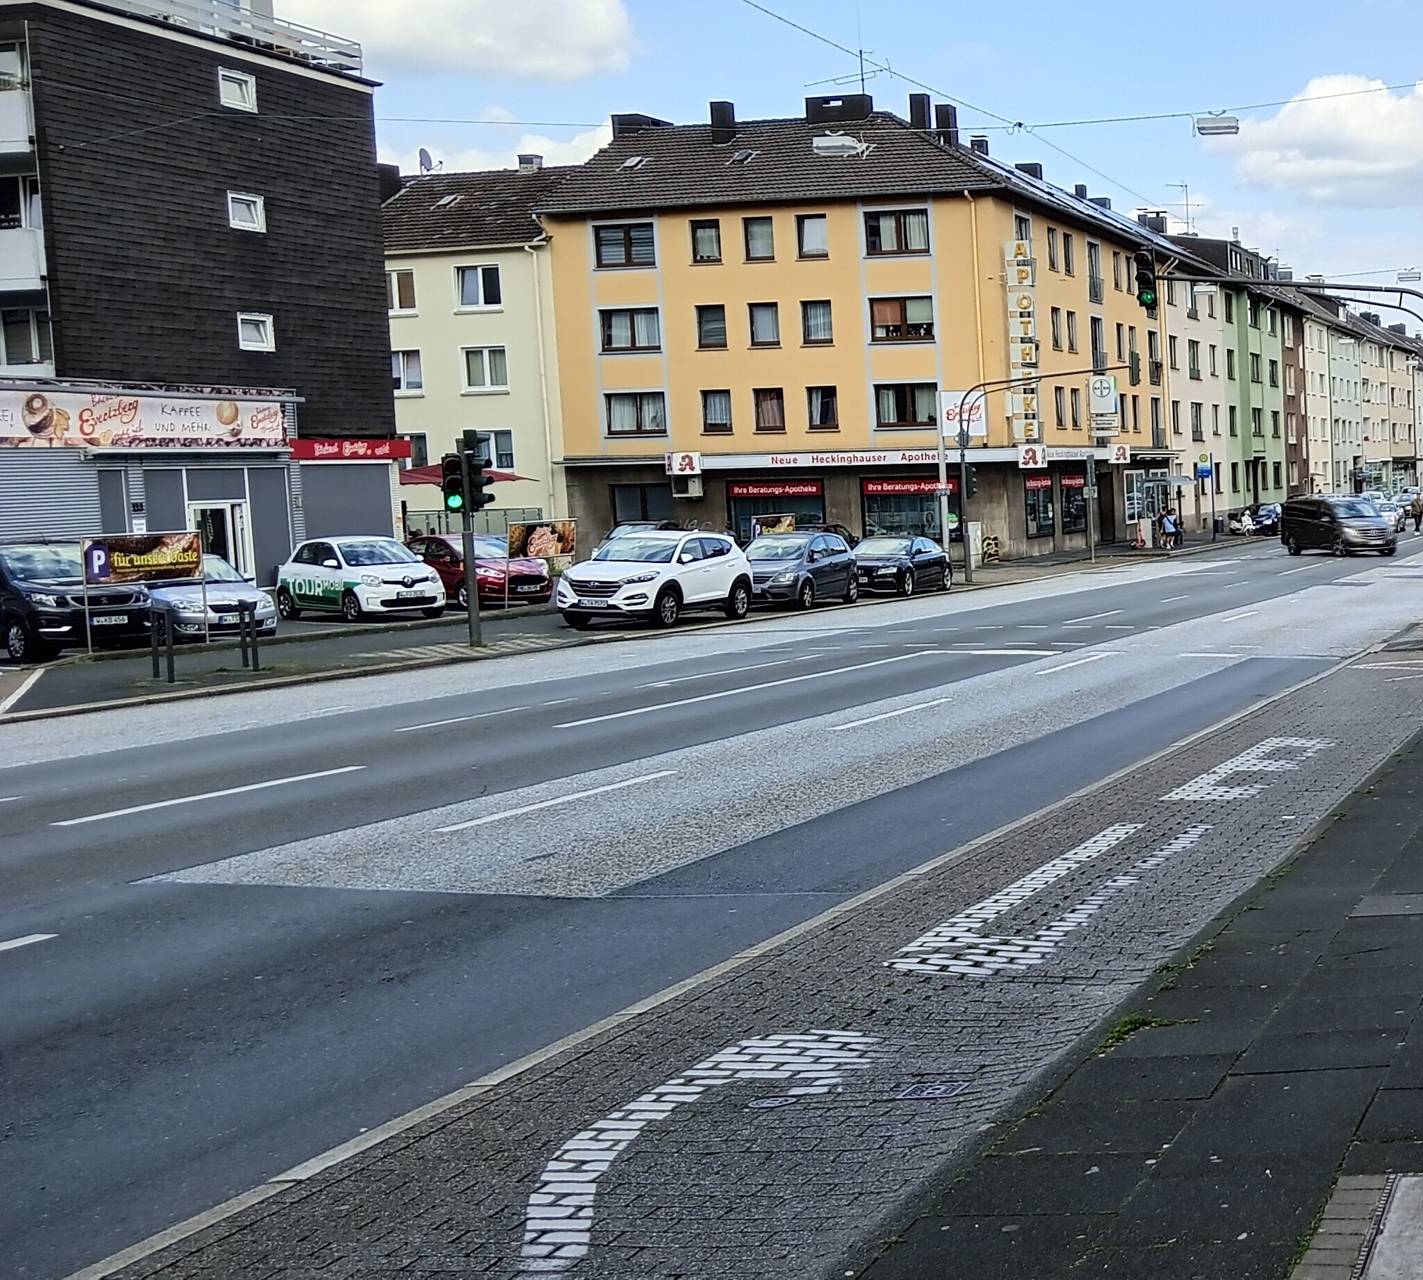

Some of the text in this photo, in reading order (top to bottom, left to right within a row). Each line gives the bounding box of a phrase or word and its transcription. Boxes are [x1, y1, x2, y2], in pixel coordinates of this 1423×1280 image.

[1014, 242, 1037, 438] APOTHKE
[160, 403, 202, 417] KAFFEE
[154, 422, 175, 432] UND
[181, 422, 211, 433] MEHR
[771, 455, 798, 465] Neue
[811, 453, 887, 465] Heckinghauser
[733, 484, 817, 495] Ihre Beratungs-Apotheke
[867, 483, 882, 491] Ihre
